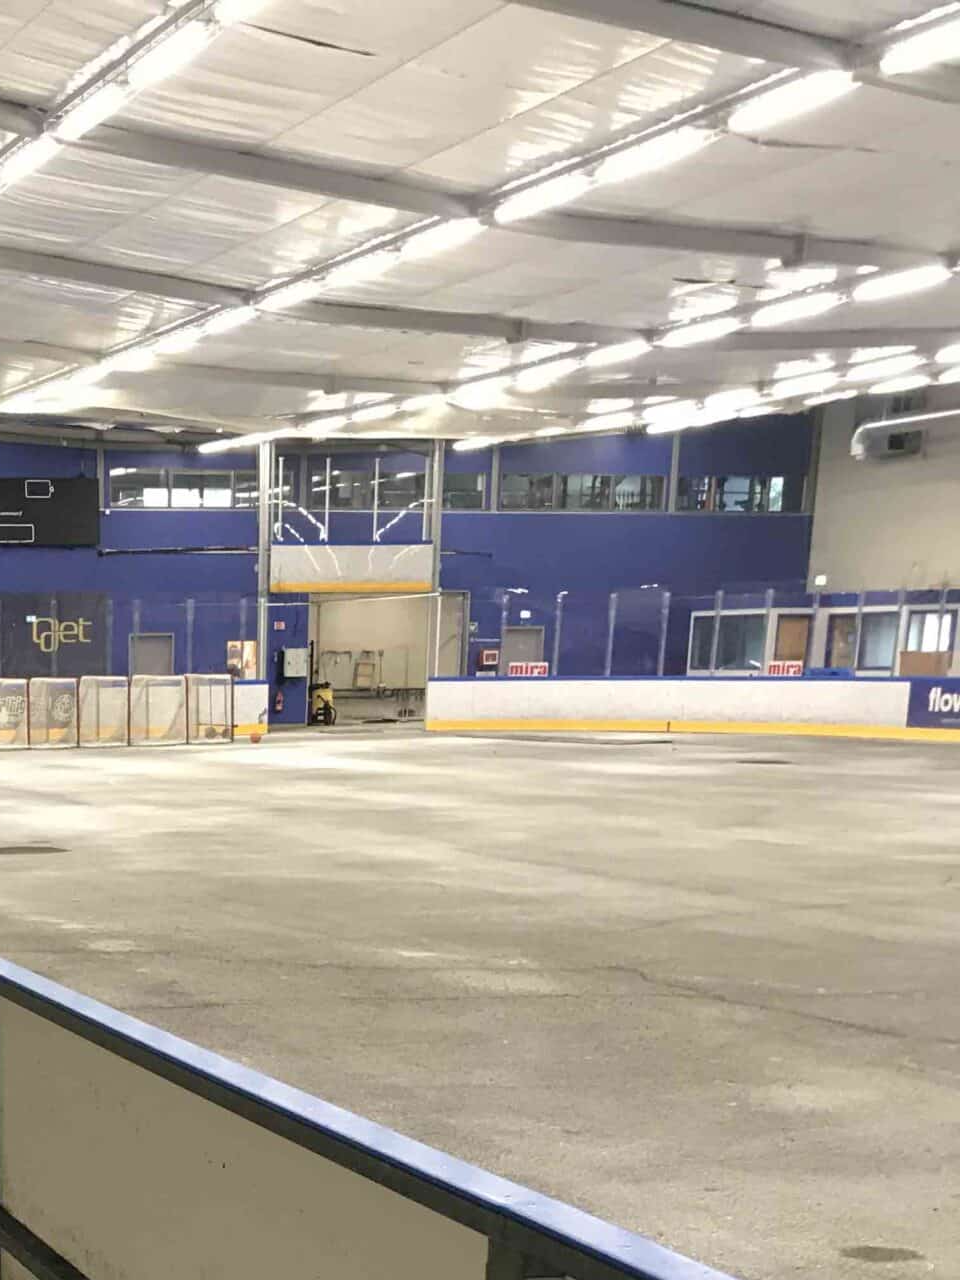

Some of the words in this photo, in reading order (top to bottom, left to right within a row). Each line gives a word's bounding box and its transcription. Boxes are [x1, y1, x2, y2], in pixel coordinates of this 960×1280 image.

[32, 617, 91, 652] get
[510, 664, 547, 675] mira
[768, 663, 801, 675] mira
